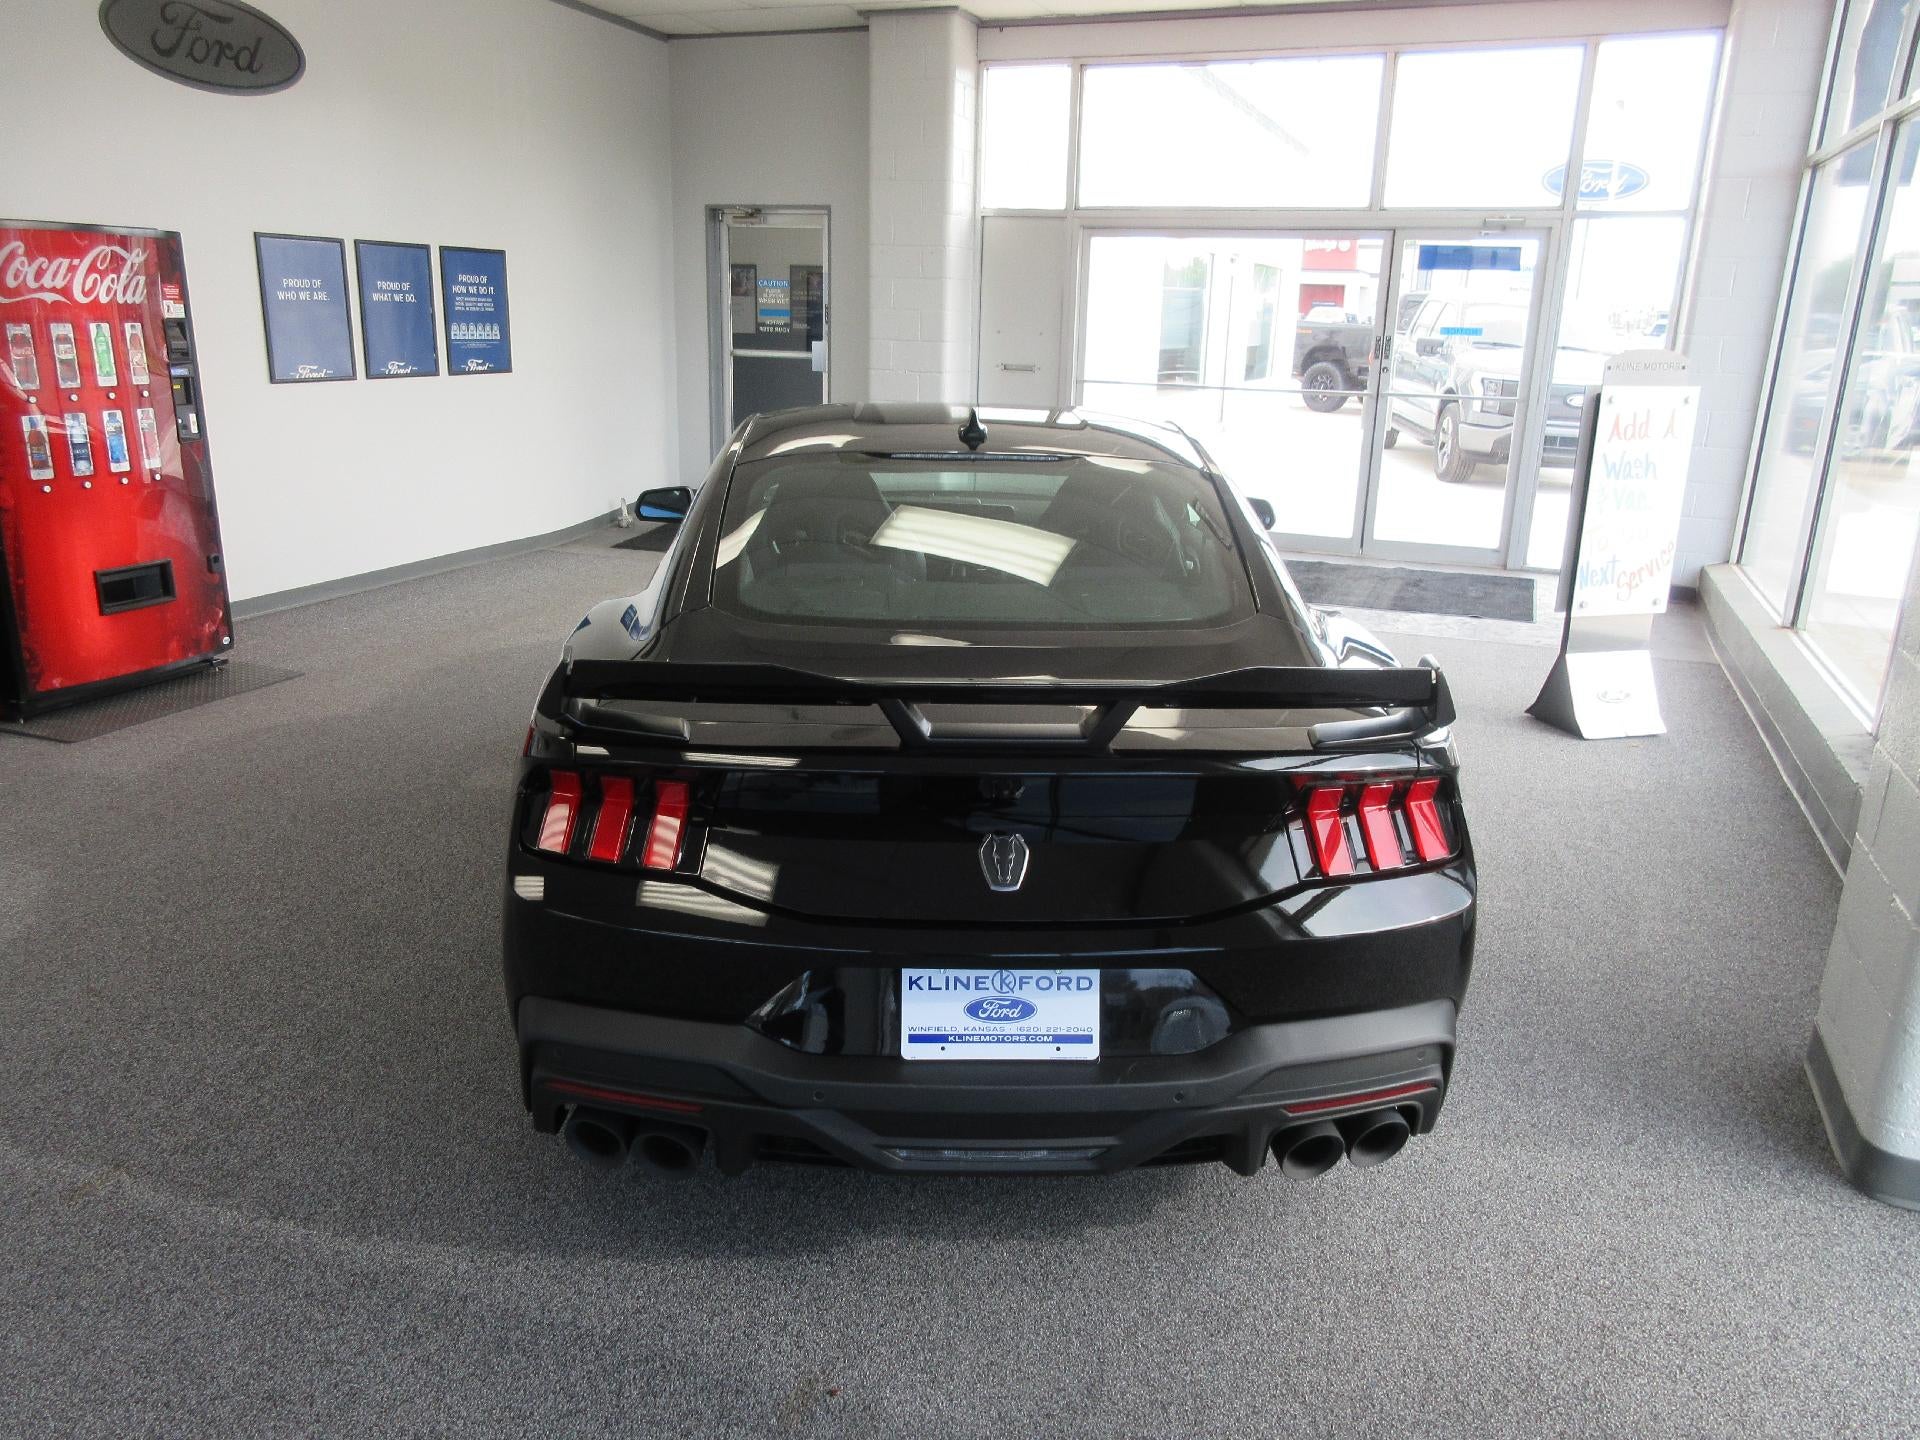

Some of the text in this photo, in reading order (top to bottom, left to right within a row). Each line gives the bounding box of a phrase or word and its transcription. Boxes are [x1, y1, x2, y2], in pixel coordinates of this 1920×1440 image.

[150, 1, 264, 74] Ford
[283, 278, 322, 288] PROUD OF
[458, 274, 488, 284] PROUD OF
[377, 281, 411, 290] PROUD OF
[452, 285, 467, 294] HOW
[468, 286, 478, 294] WE
[478, 286, 488, 294] DO
[277, 291, 330, 300] WHO WE ARE.
[372, 293, 416, 303] WHAT WE DO.
[1614, 361, 1682, 372] KLINE MOTORS
[1607, 408, 1678, 443] Add A
[1602, 450, 1658, 480] Wash
[1579, 552, 1621, 591] Next
[908, 976, 990, 991] KLINE
[1018, 976, 1093, 992] FORD
[978, 1000, 1022, 1018] Ford
